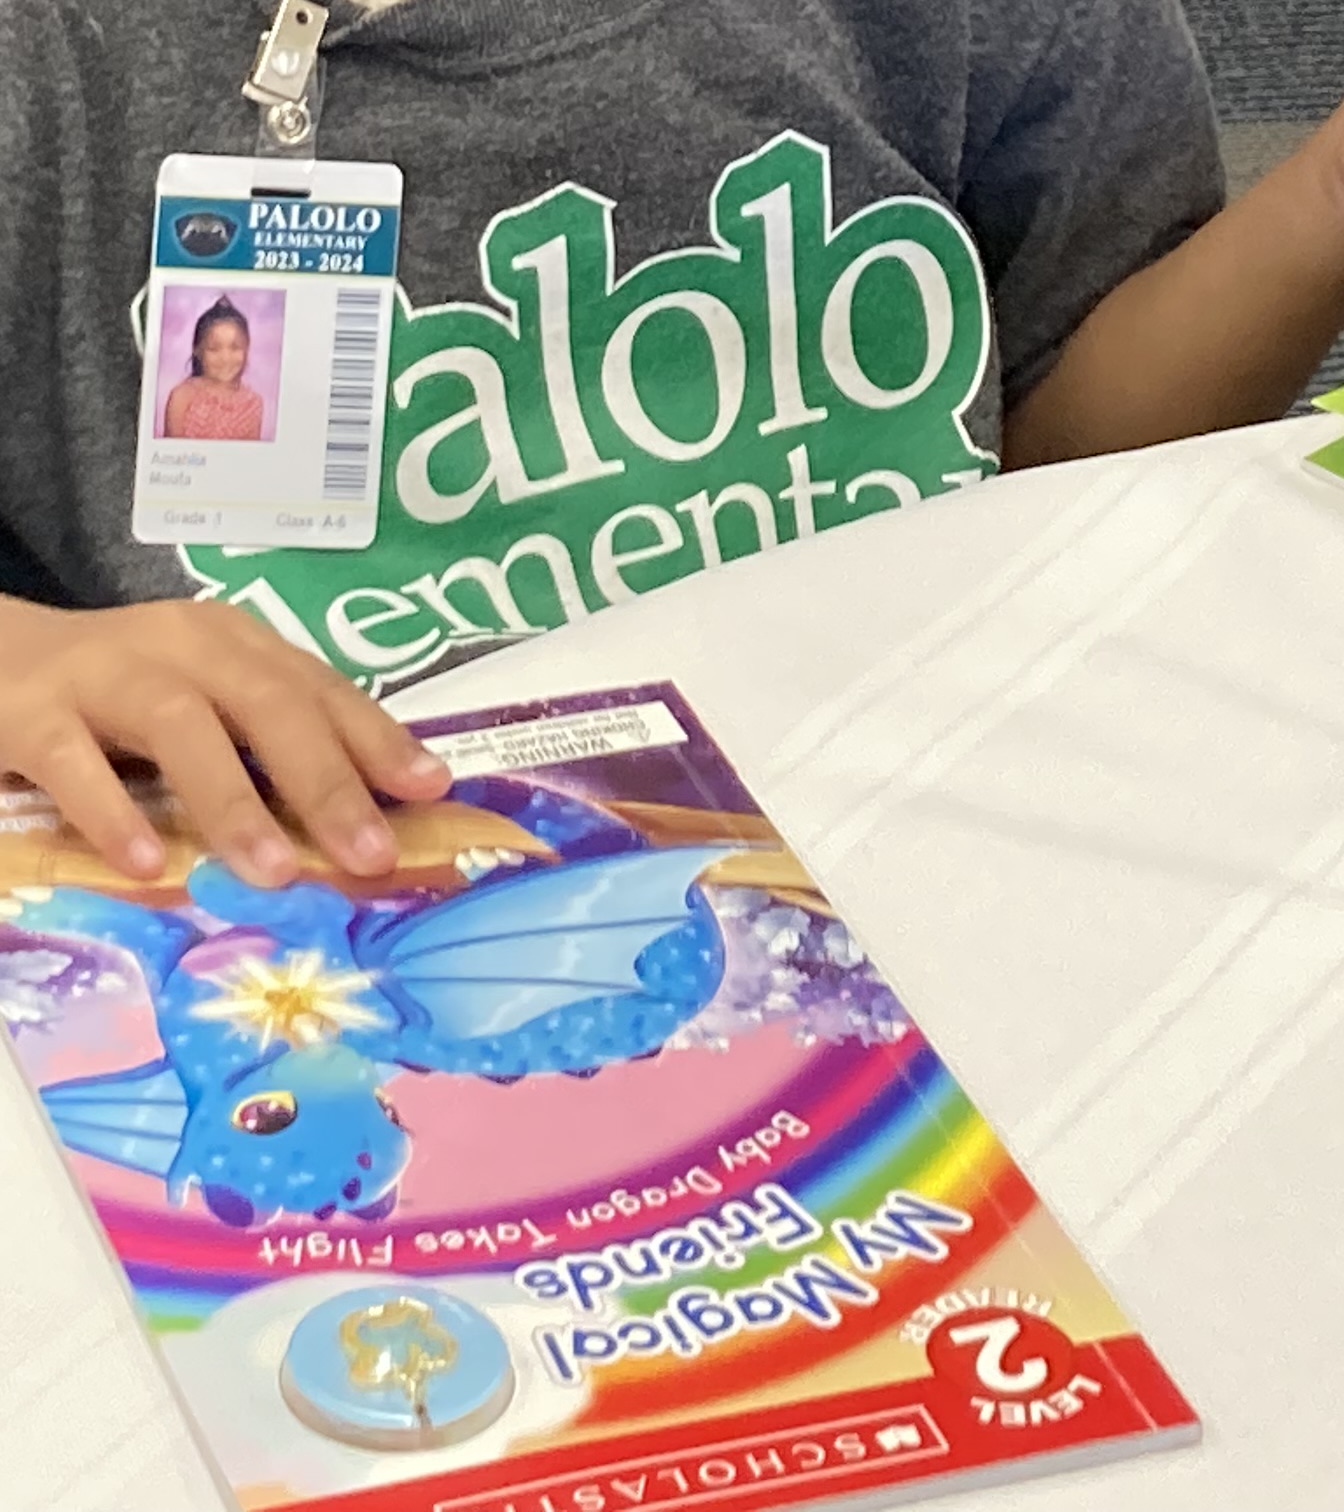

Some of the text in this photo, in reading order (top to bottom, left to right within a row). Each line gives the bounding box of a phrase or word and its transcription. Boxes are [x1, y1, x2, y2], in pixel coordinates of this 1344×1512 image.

[248, 203, 382, 233] PALOLO
[254, 231, 368, 251] ELEMENTARY
[254, 249, 300, 270] 2023
[317, 251, 364, 273] 2024
[393, 182, 956, 525] alolo
[227, 443, 981, 688] lement
[259, 1110, 811, 1268] Baby Dragon Takes Flight
[520, 1188, 818, 1310] Friends
[540, 1193, 970, 1382] My Magical
[949, 1316, 1049, 1392] 2
[969, 1373, 1103, 1428] LEVEL
[506, 1433, 866, 1512] SCHOLAS
